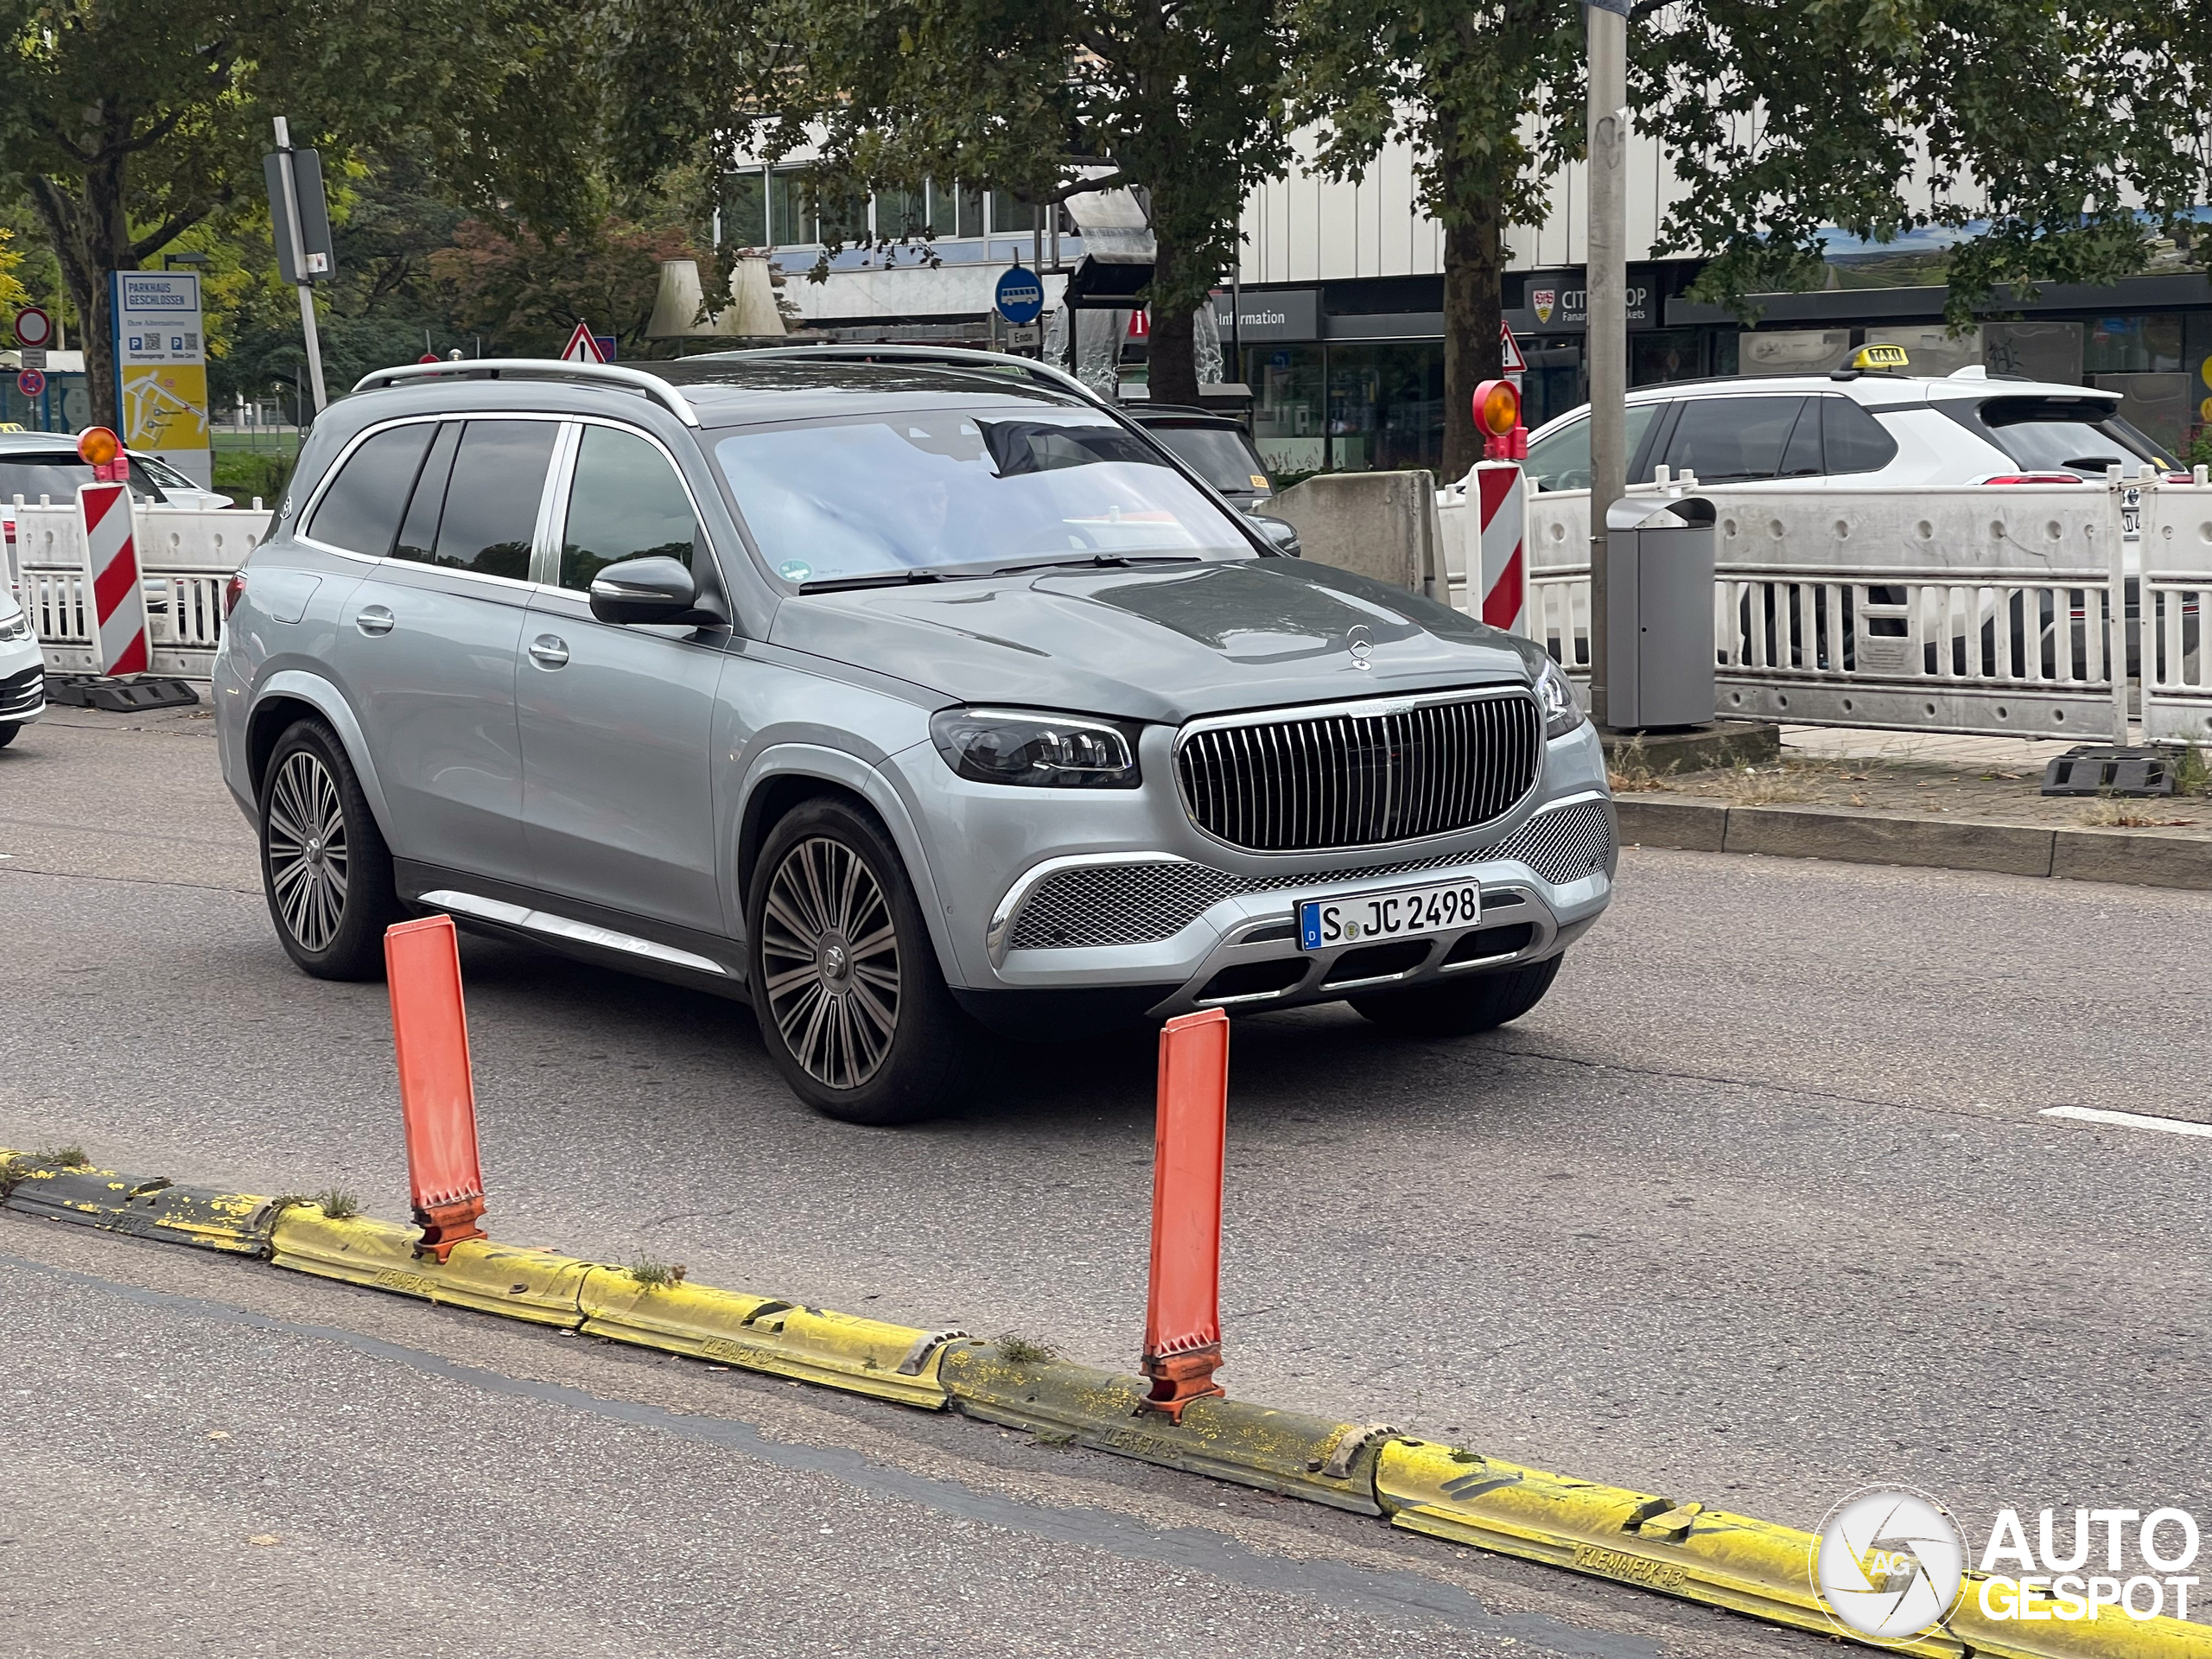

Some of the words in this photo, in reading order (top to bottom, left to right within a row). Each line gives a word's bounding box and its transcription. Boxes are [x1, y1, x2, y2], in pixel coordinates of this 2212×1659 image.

[129, 283, 170, 293] PARKHAUS
[130, 296, 185, 305] GESCHLOSSEN
[1561, 290, 1586, 308] CIT
[1216, 310, 1285, 325] -Infrmation
[1562, 312, 1587, 321] Fanar
[1014, 332, 1033, 343] Ende
[1871, 349, 1900, 361] TAXI
[1323, 906, 1342, 941] S
[1363, 899, 1401, 936] JC
[1408, 887, 1476, 930] 2498
[1308, 931, 1316, 941] D
[1576, 1548, 1661, 1584] KLEMMFIX
